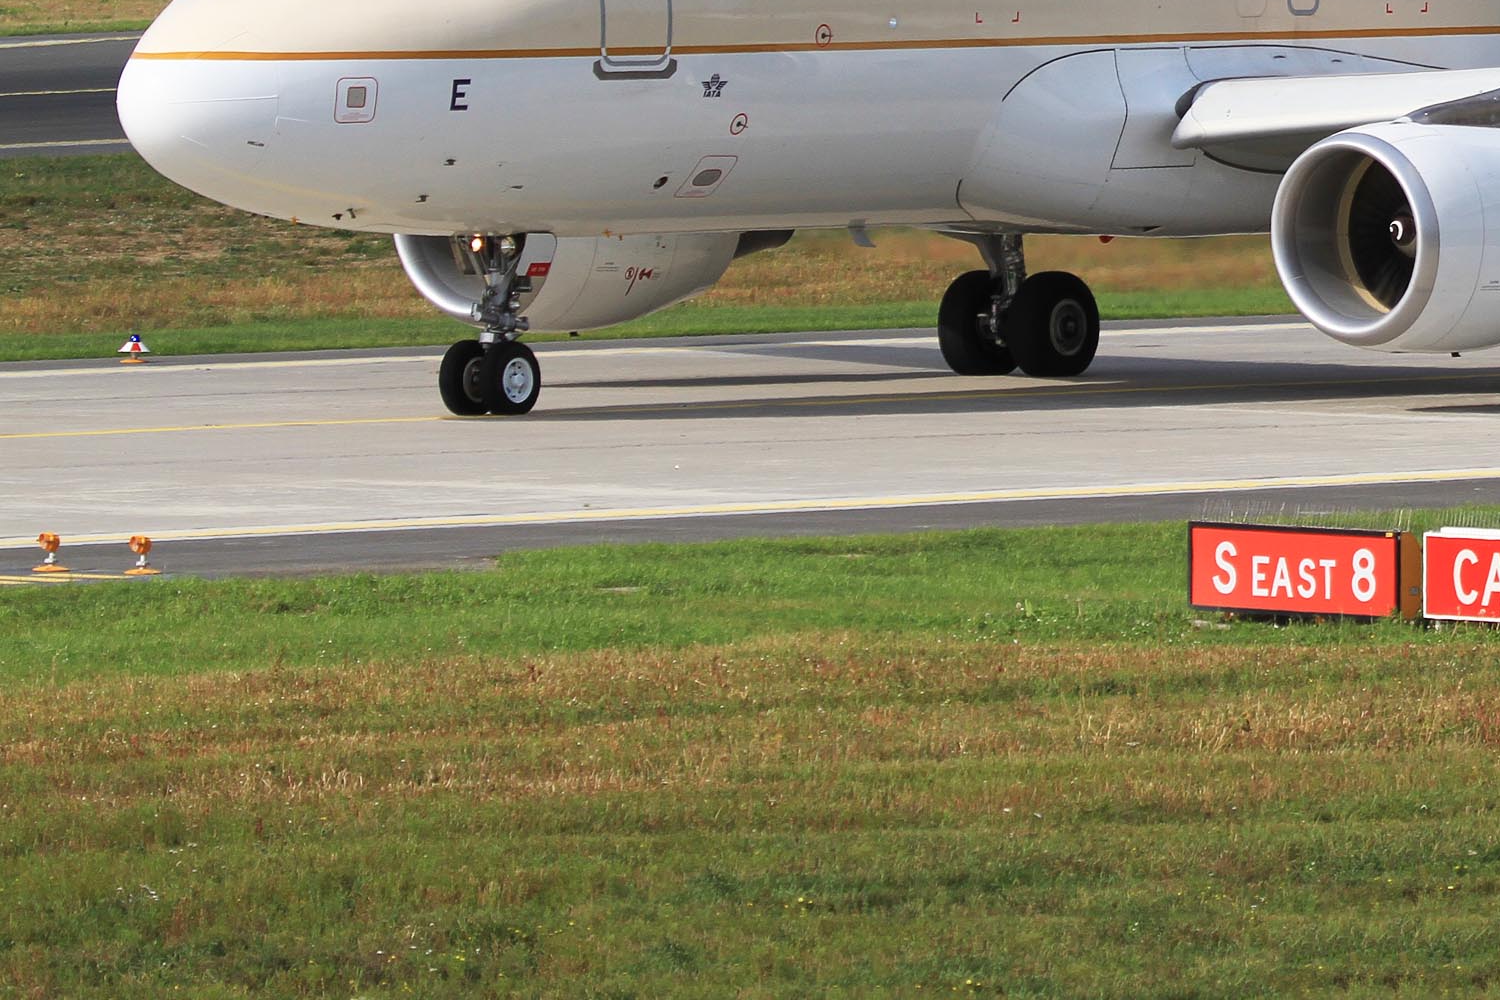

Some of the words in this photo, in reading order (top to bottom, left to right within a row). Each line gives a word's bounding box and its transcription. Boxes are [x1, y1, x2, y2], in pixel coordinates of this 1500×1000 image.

[450, 79, 471, 111] E
[703, 90, 721, 98] IATA
[1212, 541, 1237, 594] S
[1251, 555, 1337, 599] EAST
[1351, 548, 1376, 602] 8
